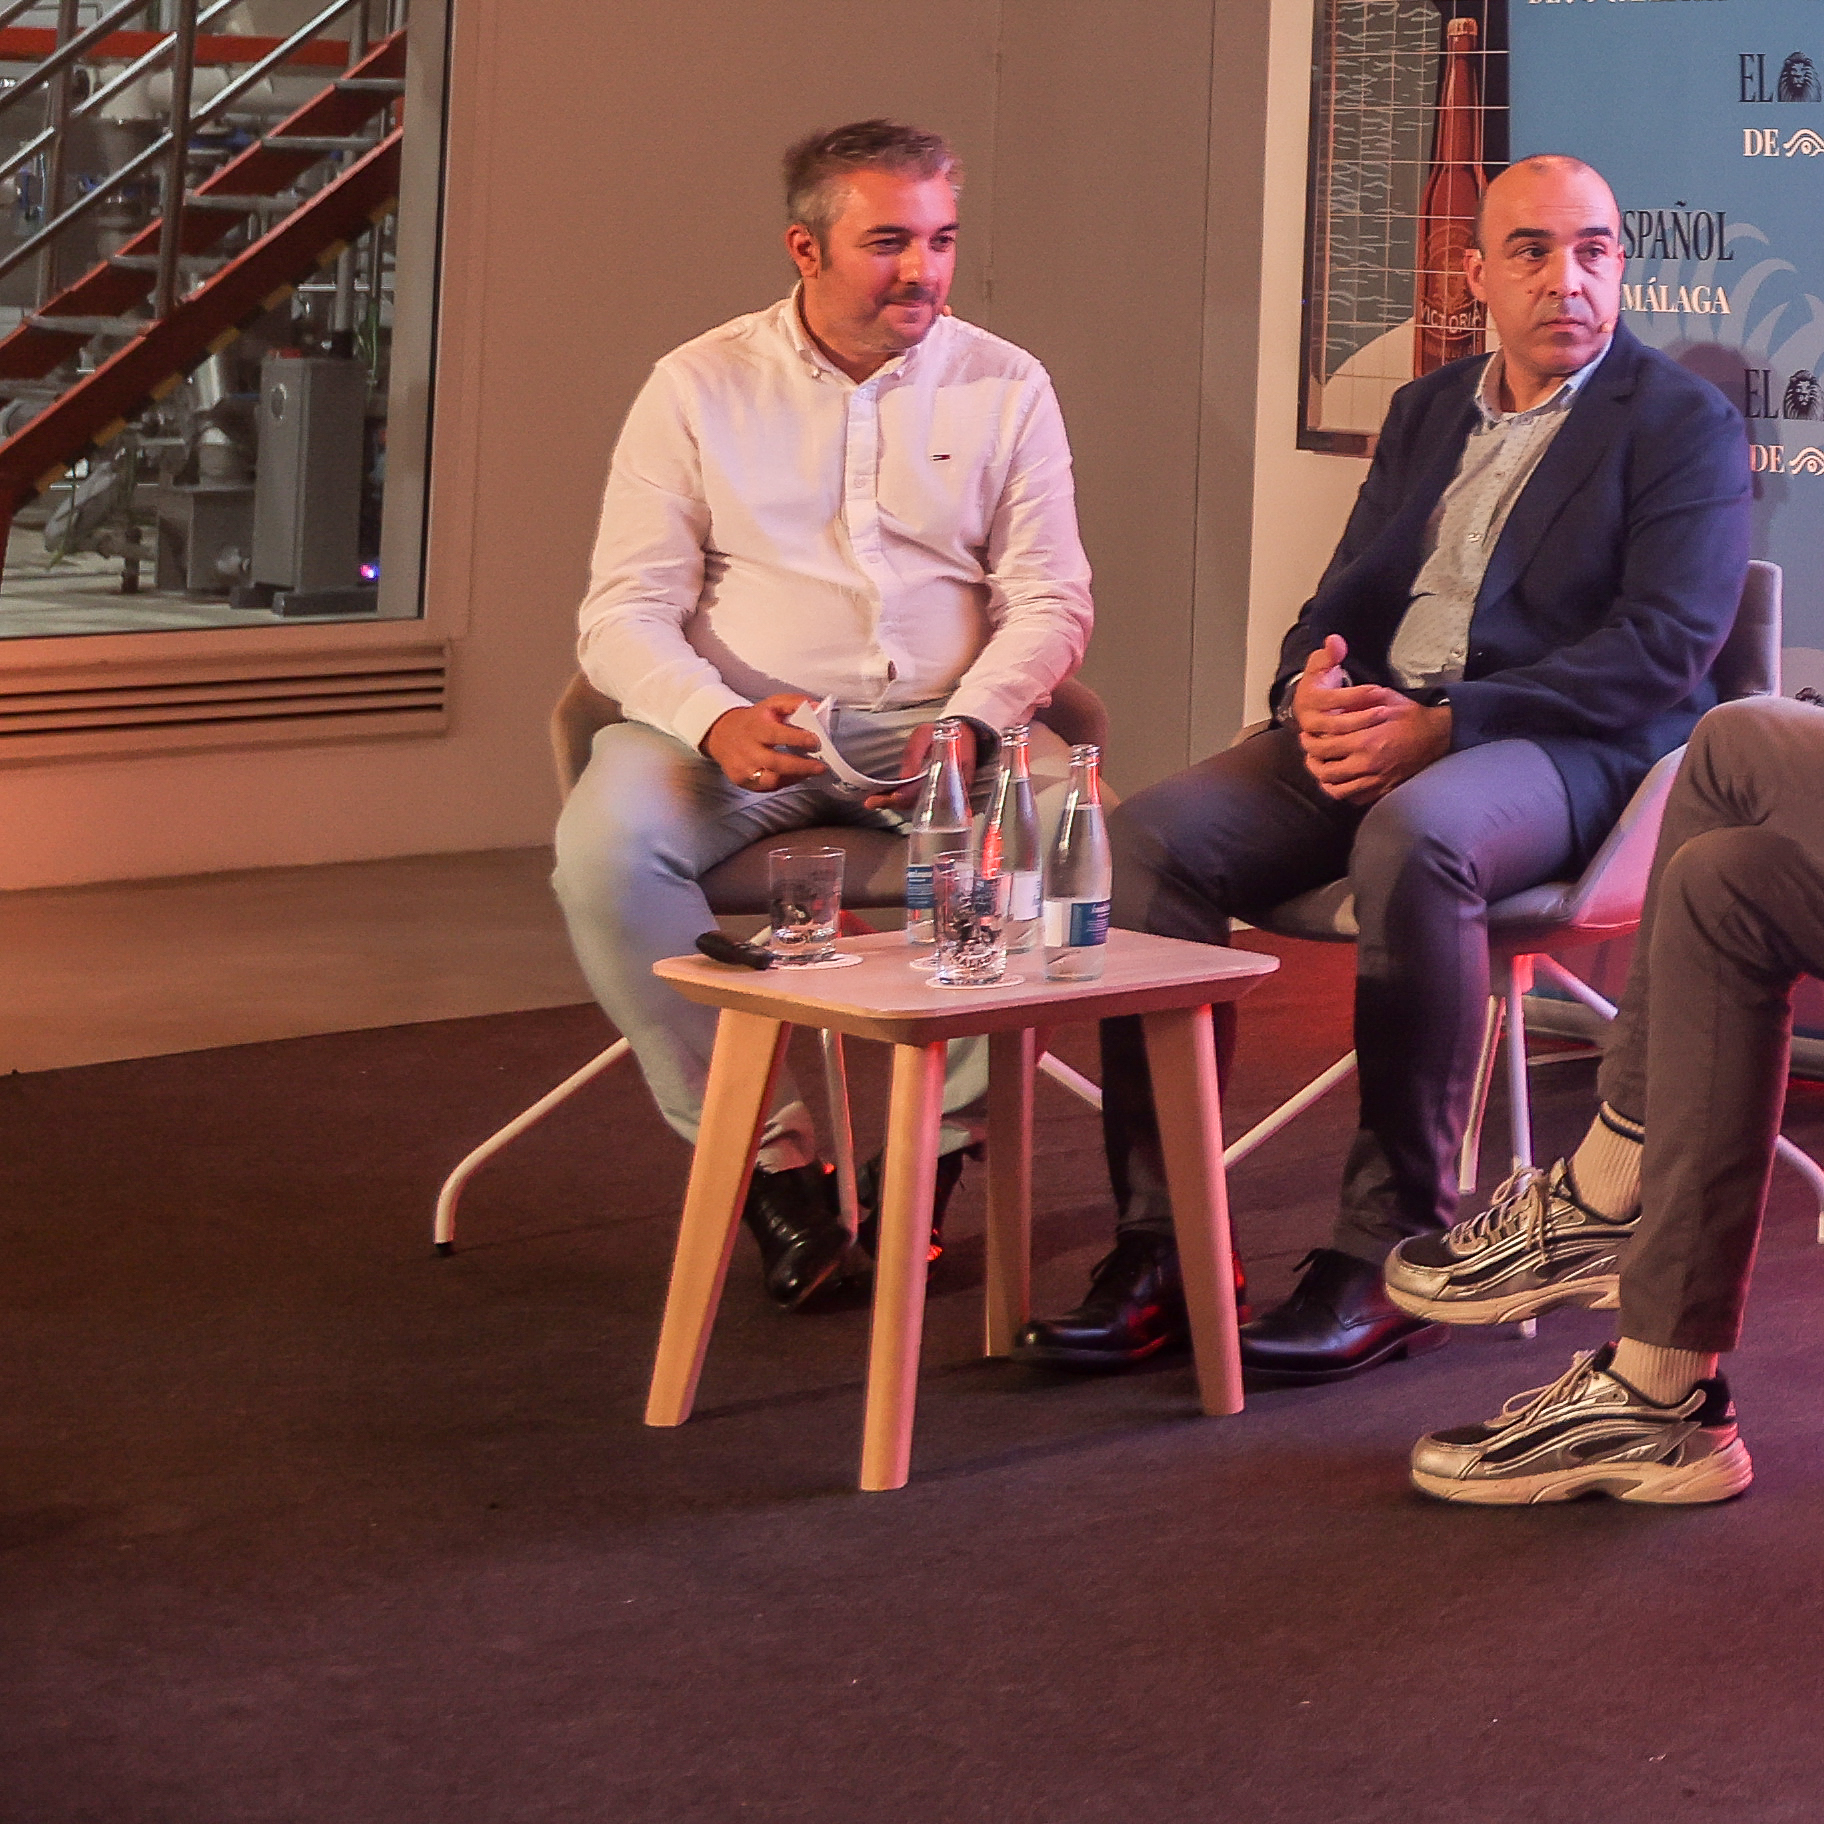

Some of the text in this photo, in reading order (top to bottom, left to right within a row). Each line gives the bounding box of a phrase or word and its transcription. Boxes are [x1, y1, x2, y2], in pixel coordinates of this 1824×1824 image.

[1739, 52, 1773, 103] EL
[1743, 128, 1779, 157] DE
[1623, 200, 1734, 261] SPAÑOL
[1621, 277, 1732, 314] MÁLAGA
[1744, 369, 1780, 419] EL
[1749, 443, 1785, 474] DE
